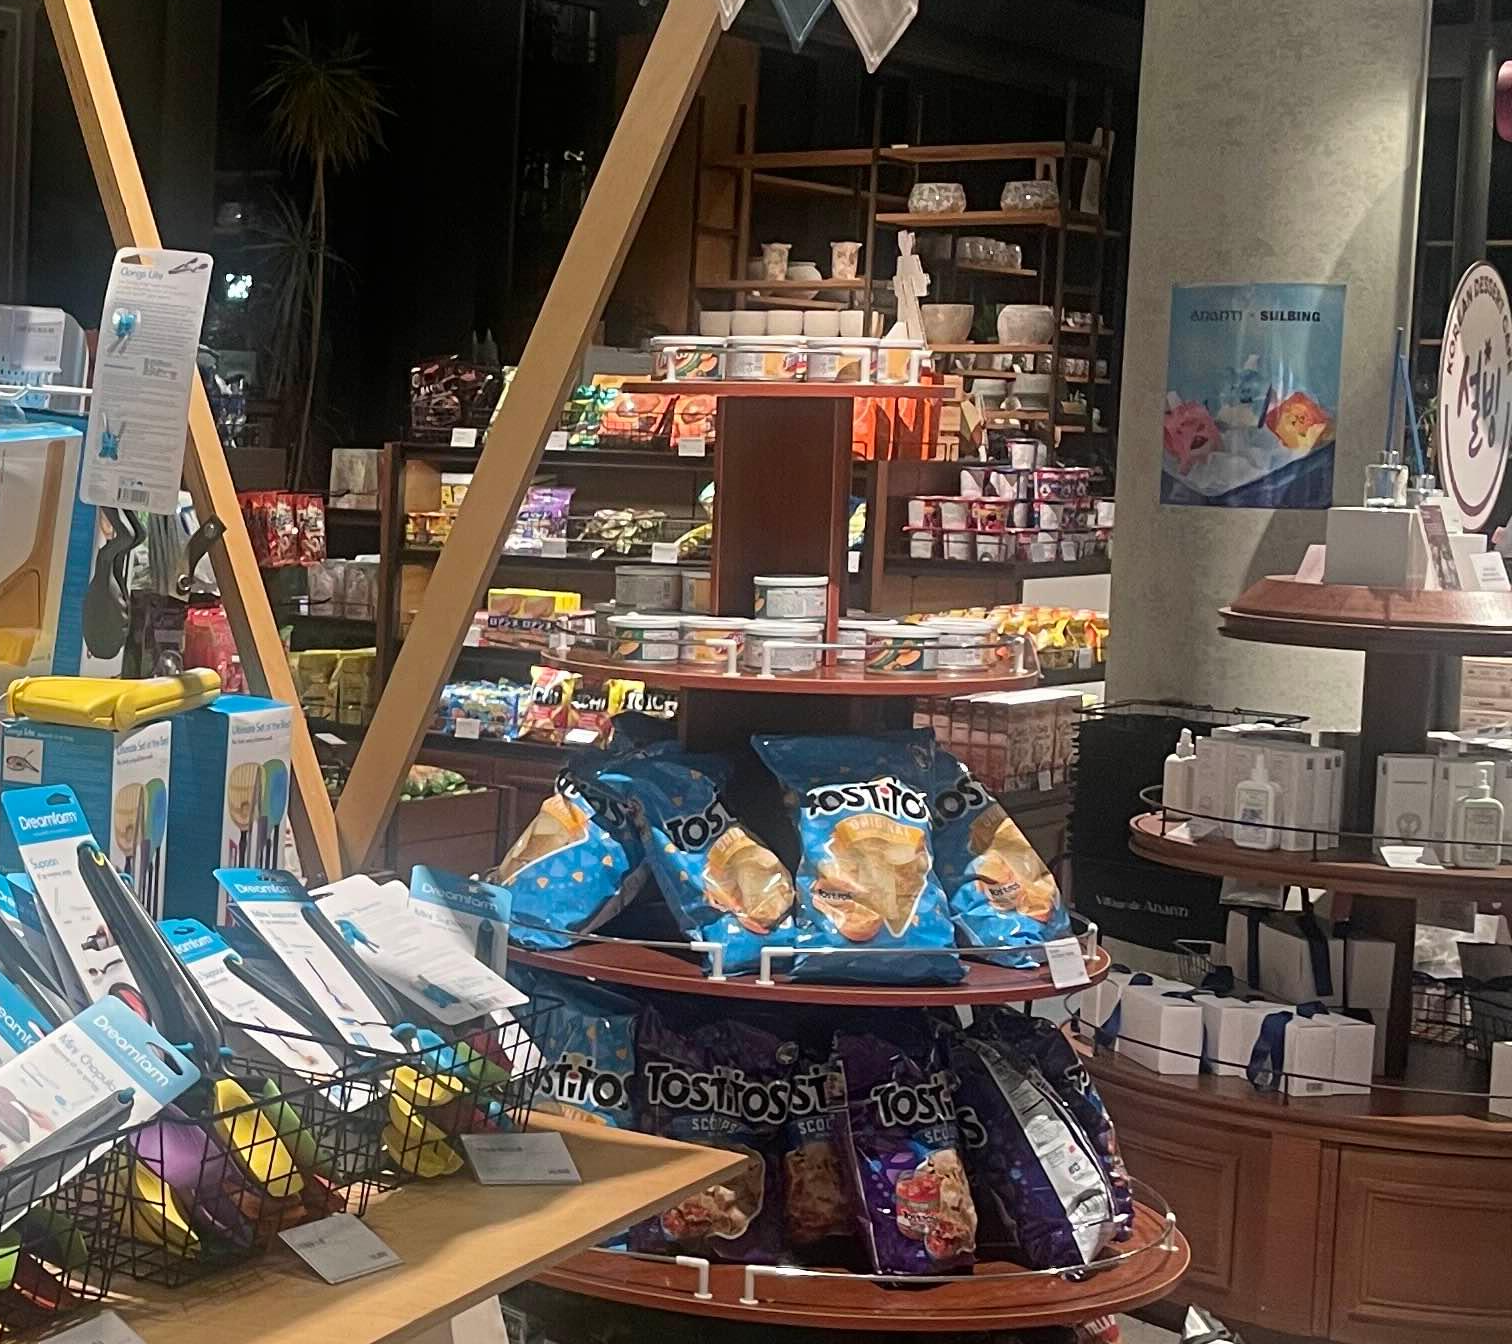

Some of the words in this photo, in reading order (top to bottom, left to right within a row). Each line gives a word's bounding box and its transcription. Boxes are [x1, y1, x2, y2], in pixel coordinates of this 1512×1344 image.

[1259, 310, 1321, 322] SULBING
[18, 811, 77, 831] Dreamfarm
[93, 1014, 169, 1088] Dreamfarm
[646, 1063, 788, 1123] TOSTITOS
